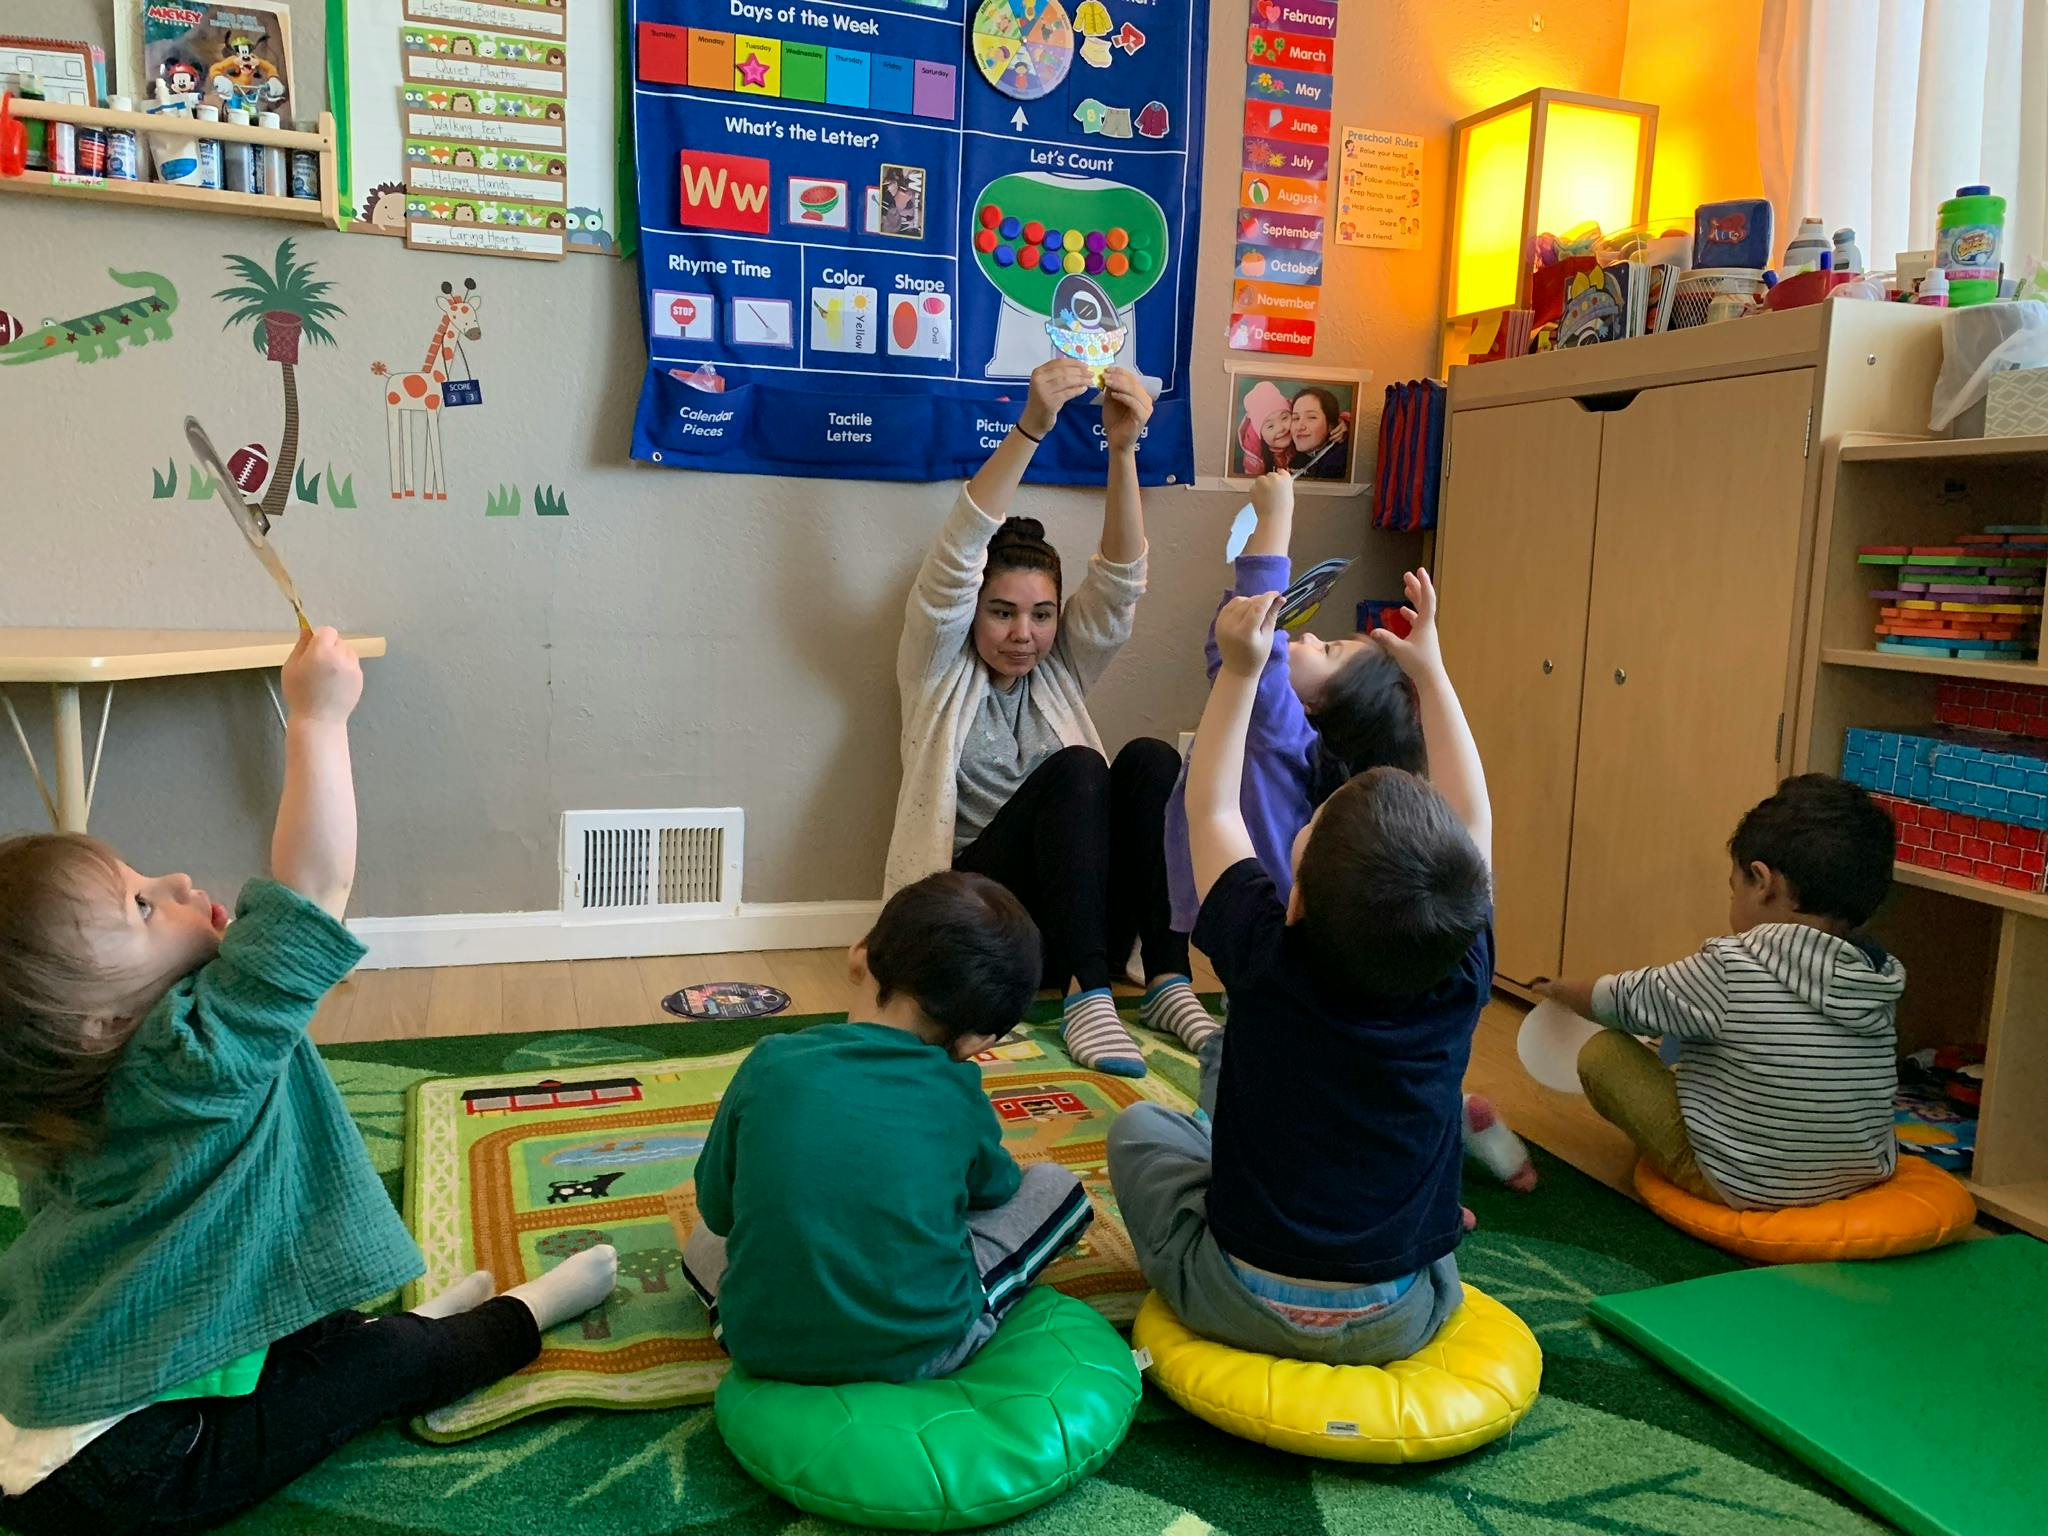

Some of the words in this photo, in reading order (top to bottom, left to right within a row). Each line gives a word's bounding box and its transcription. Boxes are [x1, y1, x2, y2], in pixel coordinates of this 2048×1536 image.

[148, 6, 202, 23] MICKEY
[421, 0, 471, 17] Listening
[476, 6, 516, 22] Bodies
[731, 0, 772, 22] Days
[778, 7, 795, 23] of
[801, 10, 828, 28] the
[833, 14, 879, 35] Week
[1283, 8, 1335, 29] February
[650, 29, 677, 39] Sunday
[698, 35, 725, 46] Monday
[745, 41, 772, 52] Tuesday
[786, 47, 822, 58] Wednesday
[835, 54, 863, 65] Thursday
[921, 66, 949, 78] Saturday
[1289, 46, 1326, 63] March
[435, 57, 469, 75] Quiet
[479, 63, 517, 81] Mouths
[1295, 83, 1321, 101] May
[432, 115, 472, 134] Walking
[725, 116, 784, 138] What's
[789, 123, 817, 141] the
[821, 127, 879, 149] Letter?
[1291, 119, 1318, 134] June
[1348, 130, 1392, 145] Preschool
[1395, 137, 1419, 148] Rules
[1030, 149, 1064, 167] Let's
[1068, 153, 1114, 172] Count
[1360, 147, 1376, 156] Raise
[1378, 150, 1391, 158] your
[1291, 155, 1314, 171] July
[432, 169, 469, 188] Helping
[477, 173, 511, 190] Hands
[683, 163, 768, 214] Ww
[1277, 188, 1319, 206] August
[1350, 188, 1365, 197] Keep
[450, 228, 484, 242] Caring
[488, 230, 520, 244] Hearts
[1262, 222, 1320, 241] September
[668, 254, 727, 276] Rhyme
[732, 259, 772, 279] Time
[1270, 259, 1319, 275] October
[822, 268, 865, 286] Color
[895, 274, 945, 293] Shape
[1257, 293, 1316, 310] November
[672, 306, 694, 316] STOP
[855, 315, 865, 349] Yellow
[1254, 327, 1312, 345] December
[449, 383, 471, 392] SCORE
[679, 406, 733, 423] Calendar
[828, 412, 873, 427] Tactile
[682, 422, 723, 437] Pieces
[976, 418, 1017, 432] Pictur
[826, 430, 872, 443] Letters
